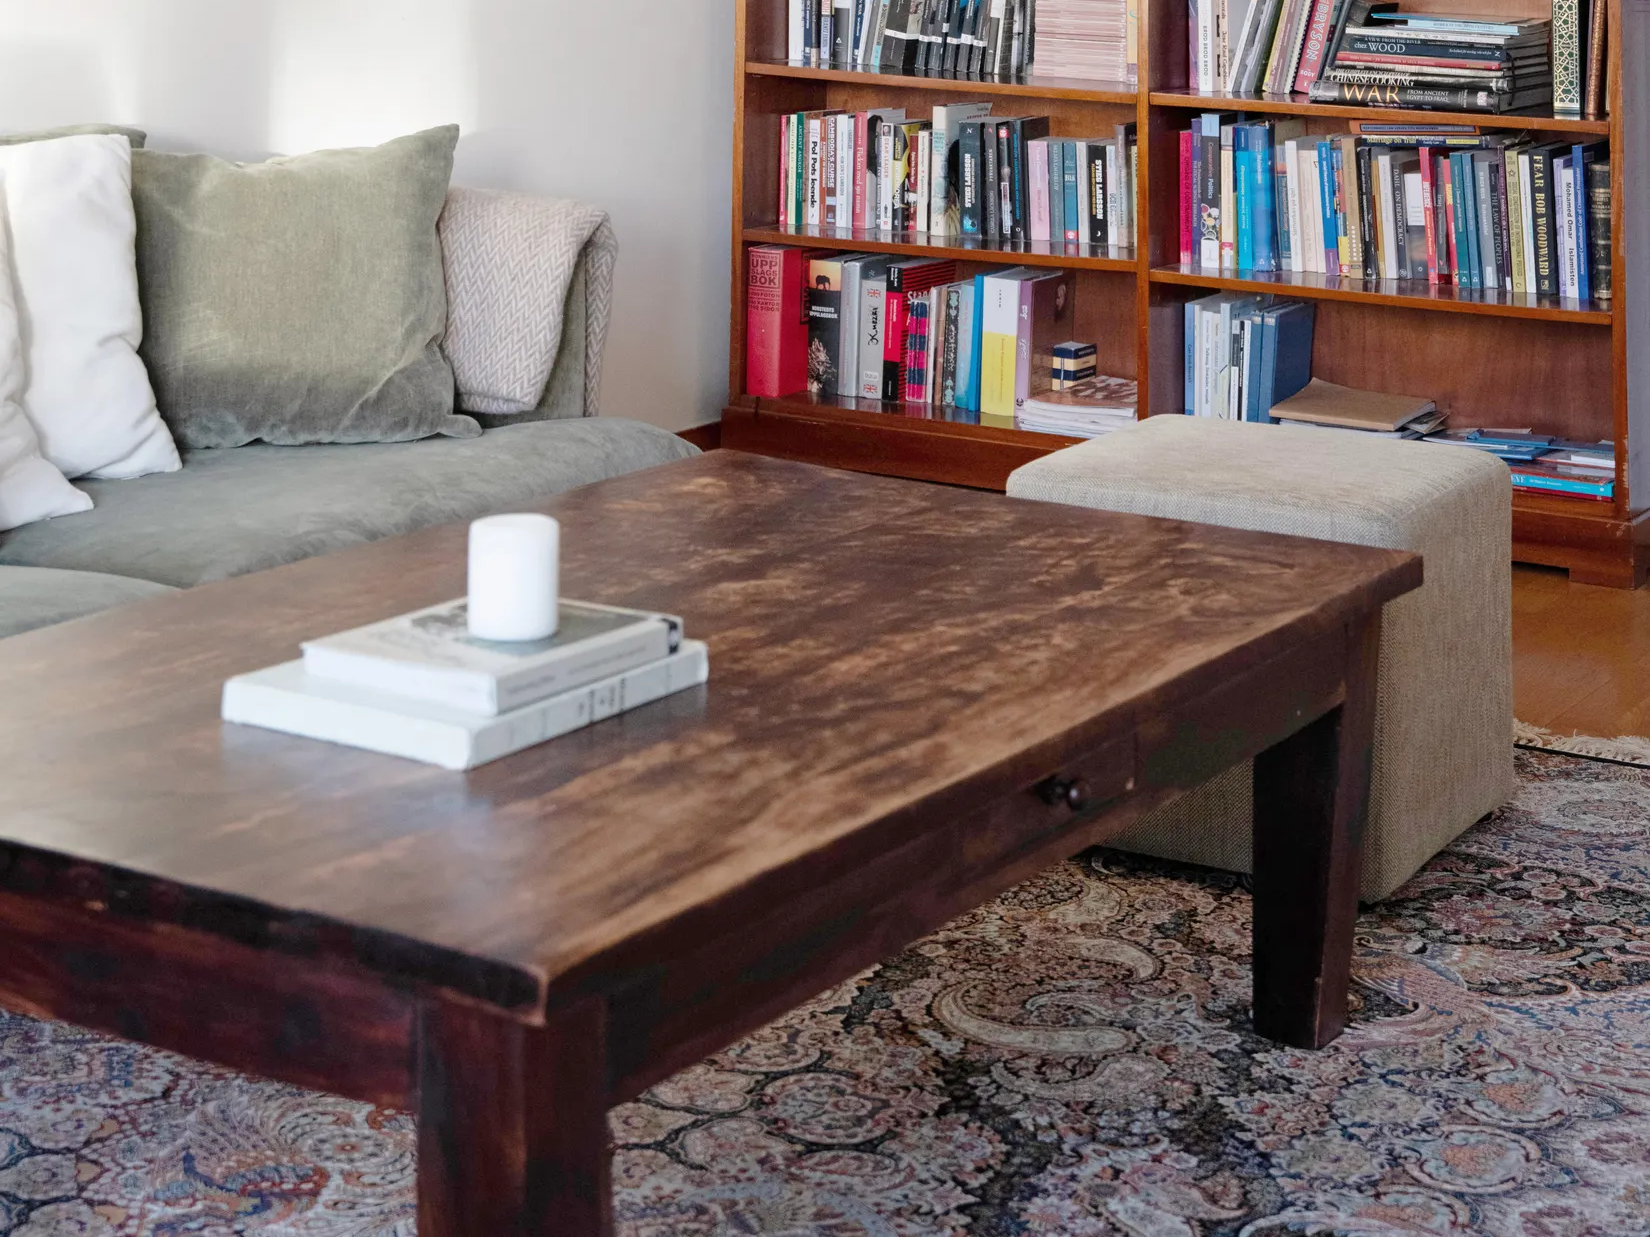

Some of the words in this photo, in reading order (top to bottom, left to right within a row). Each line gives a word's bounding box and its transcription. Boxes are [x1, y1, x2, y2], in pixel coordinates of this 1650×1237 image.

[1306, 4, 1329, 61] BRYSON
[1368, 41, 1406, 53] WOOD
[1299, 70, 1315, 78] BODY
[1330, 73, 1373, 84] CHINESE
[1372, 75, 1415, 87] COOKING
[1343, 84, 1401, 103] WAR
[827, 164, 835, 188] CURSE
[1533, 155, 1544, 187] FEAR
[964, 187, 972, 208] STIEG
[1395, 191, 1401, 201] ON
[1423, 182, 1431, 208] INFLUENCE
[1535, 193, 1546, 215] BOB
[1396, 204, 1405, 245] DEMOCRACY
[1494, 224, 1500, 234] OF
[1495, 236, 1503, 265] PEOPLES
[1536, 216, 1549, 276] WOODWARD
[751, 259, 778, 269] UPP
[750, 275, 777, 286] BOK
[809, 311, 838, 319] UPPSLAGSBOK
[812, 305, 835, 313] NORSTEDTS
